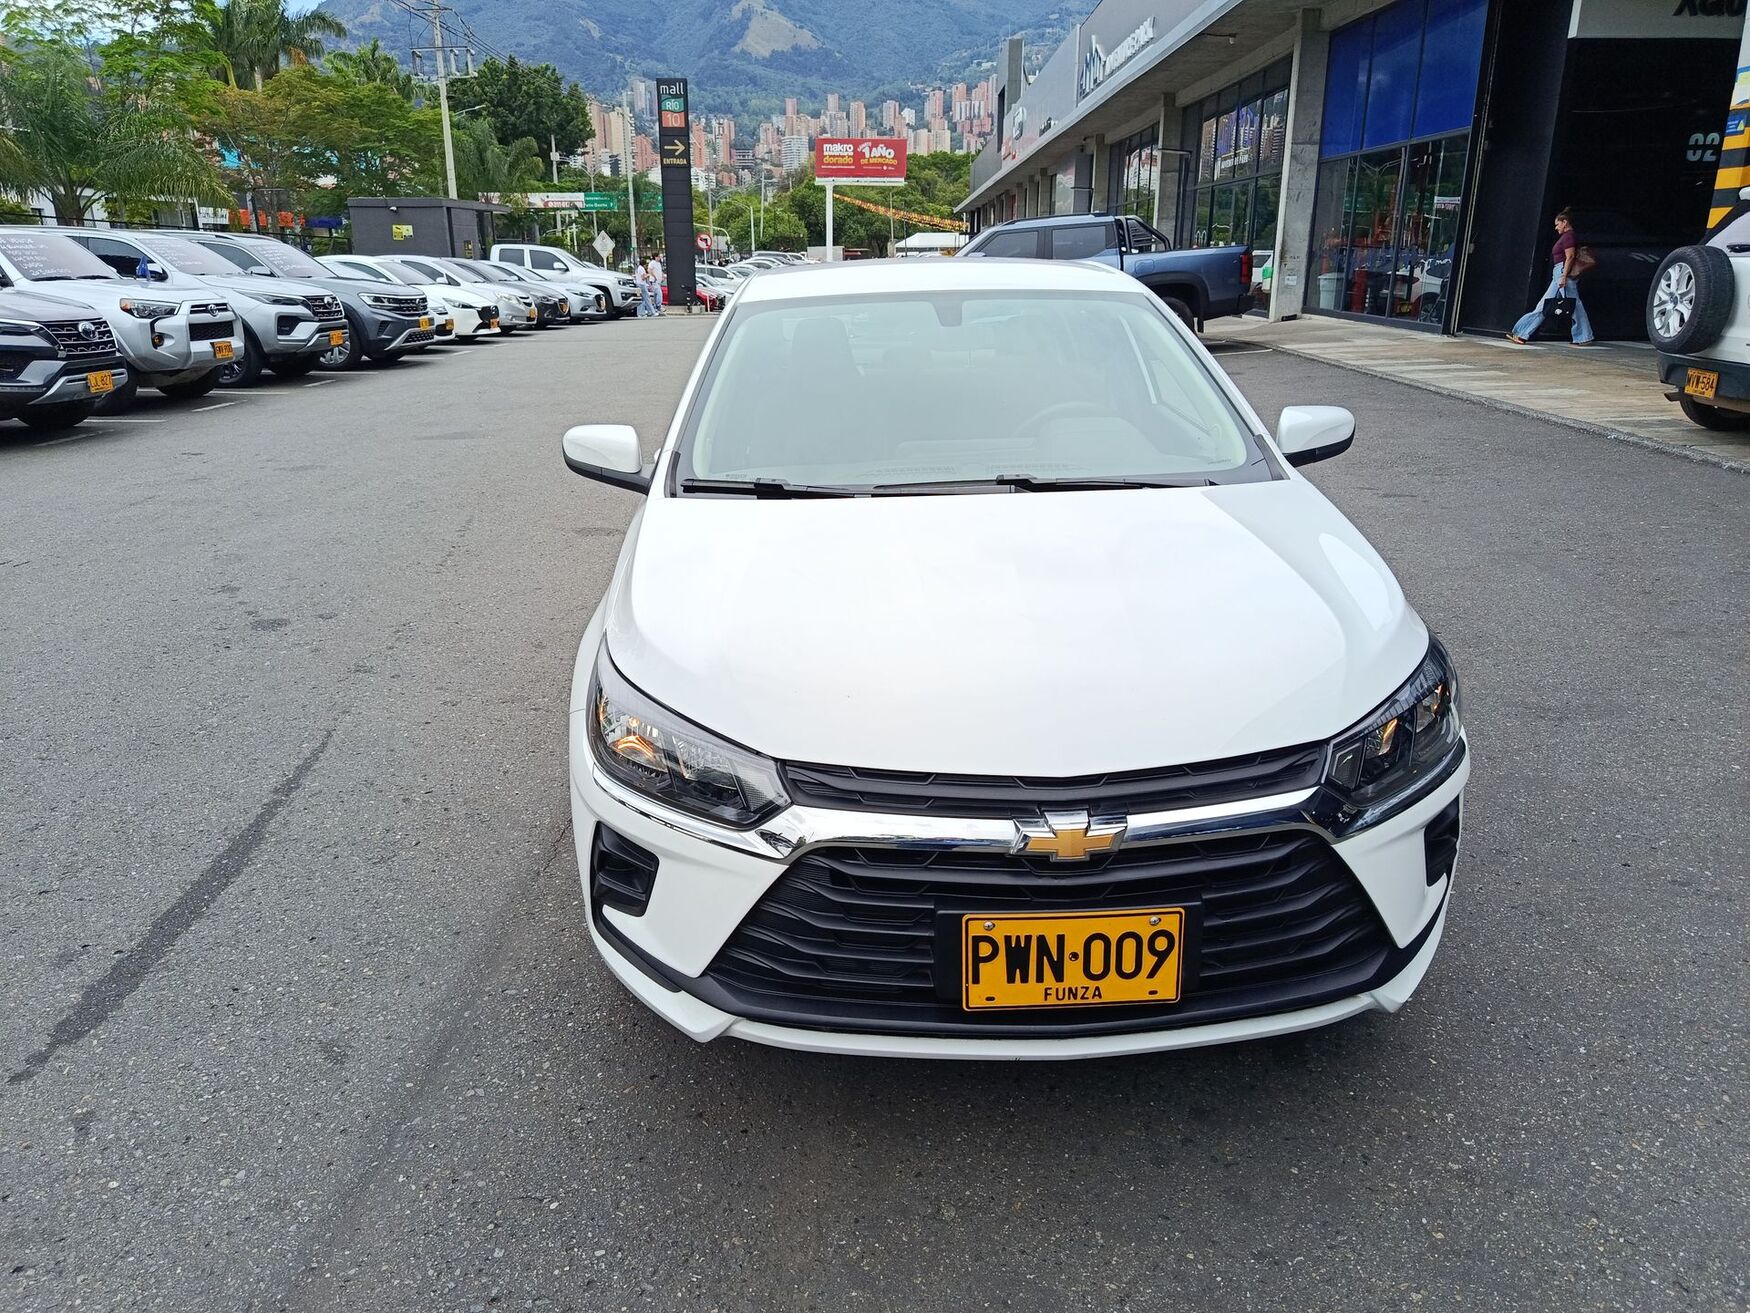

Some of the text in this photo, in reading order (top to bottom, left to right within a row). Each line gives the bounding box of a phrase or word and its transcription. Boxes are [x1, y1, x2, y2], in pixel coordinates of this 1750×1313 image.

[660, 82, 684, 94] mall
[667, 113, 681, 127] 10
[823, 143, 854, 152] makro
[871, 144, 895, 159] AÑO
[823, 155, 854, 164] dorado
[1044, 986, 1103, 1001] FUNZA
